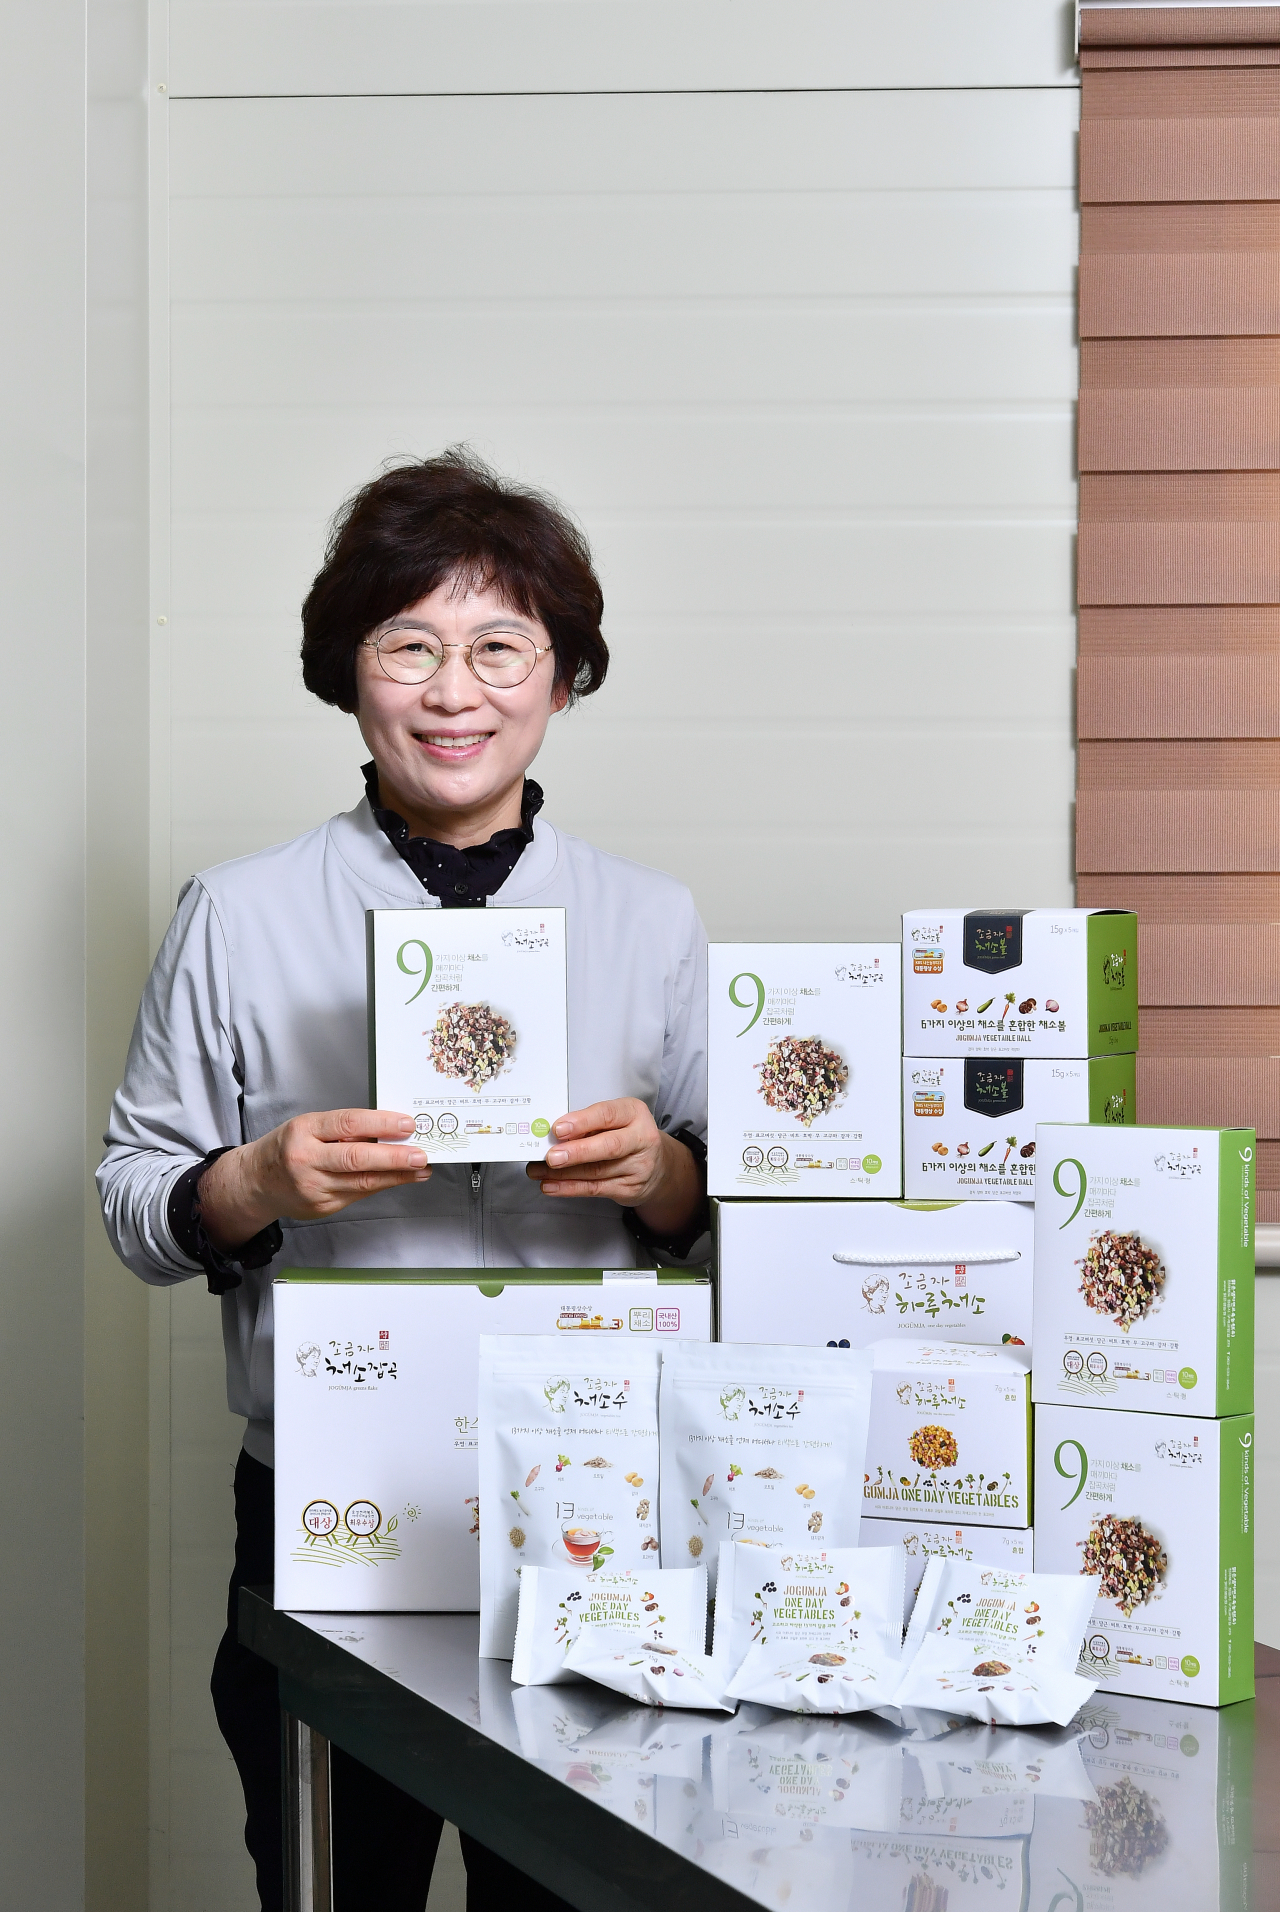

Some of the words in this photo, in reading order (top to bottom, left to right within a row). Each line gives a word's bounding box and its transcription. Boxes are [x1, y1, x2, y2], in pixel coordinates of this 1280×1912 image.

[977, 928, 1004, 939] 조금자
[1051, 925, 1063, 935] 15g
[975, 938, 1007, 955] 채소볼
[436, 954, 449, 962] 가지
[397, 939, 433, 1005] 9
[436, 964, 463, 972] 매끼마다
[435, 974, 462, 982] 잡곡처럼
[768, 988, 782, 996] 가지
[784, 988, 797, 996] 이상
[800, 988, 821, 996] 채소를
[729, 973, 765, 1038] 9
[766, 1008, 794, 1016] 잡곡처럼
[921, 1020, 944, 1029] 6가지
[948, 1020, 974, 1031] 이상의
[978, 1020, 1004, 1031] 채소를
[1009, 1020, 1035, 1031] 혼합한
[1039, 1020, 1066, 1032] 채소볼
[977, 1072, 1004, 1082] 조금자
[1051, 1069, 1064, 1078] 15g
[976, 1082, 1008, 1098] 채소볼
[1239, 1147, 1252, 1162] 9
[922, 1163, 946, 1172] 6가지
[949, 1163, 975, 1174] 이상의
[979, 1163, 1006, 1175] 채소를
[1090, 1177, 1104, 1185] 가지
[1105, 1178, 1118, 1186] 이상
[1120, 1178, 1140, 1187] 채소를
[1053, 1158, 1087, 1230] 9
[1090, 1188, 1116, 1196] 매끼마다
[1244, 1190, 1249, 1199] of
[1088, 1198, 1114, 1208] 잡곡처럼
[899, 1272, 949, 1290] 조금자
[896, 1290, 985, 1318] 하루채소
[329, 1341, 374, 1356] 조금자
[325, 1358, 397, 1382] 채소잡곡
[584, 1378, 617, 1390] 조금자
[917, 1382, 945, 1392] 조금자
[759, 1387, 791, 1400] 조금자
[574, 1391, 627, 1409] 채소수
[915, 1393, 966, 1409] 하루채소
[749, 1399, 801, 1420] 채소수
[1239, 1433, 1252, 1448] 9
[1091, 1459, 1105, 1468] 가지
[1106, 1461, 1119, 1469] 이상
[1121, 1462, 1141, 1472] 채소를
[1054, 1440, 1088, 1511] 9
[1091, 1471, 1117, 1481] 매끼마다
[1244, 1476, 1249, 1484] of
[1089, 1481, 1115, 1491] 잡곡처럼
[863, 1486, 899, 1500] GUMJA
[902, 1489, 921, 1501] ONE
[924, 1490, 944, 1504] DAY
[948, 1491, 1018, 1508] VEGETABLES
[556, 1502, 574, 1519] 13
[309, 1517, 332, 1529] 대상
[727, 1512, 744, 1529] 13
[747, 1524, 784, 1532] vegetable
[924, 1533, 952, 1544] 조금자
[784, 1586, 827, 1596] JOGUMJA
[589, 1593, 631, 1602] JOGUMJA
[785, 1598, 802, 1608] ONE
[806, 1598, 824, 1608] DAY
[590, 1602, 608, 1611] ONE
[610, 1602, 628, 1611] DAY
[579, 1611, 639, 1622] VEGETABLES
[774, 1608, 835, 1620] VEGETABLES
[975, 1609, 991, 1617] ONE
[992, 1609, 1011, 1621] DAY
[962, 1618, 1018, 1633] VEGETABLES
